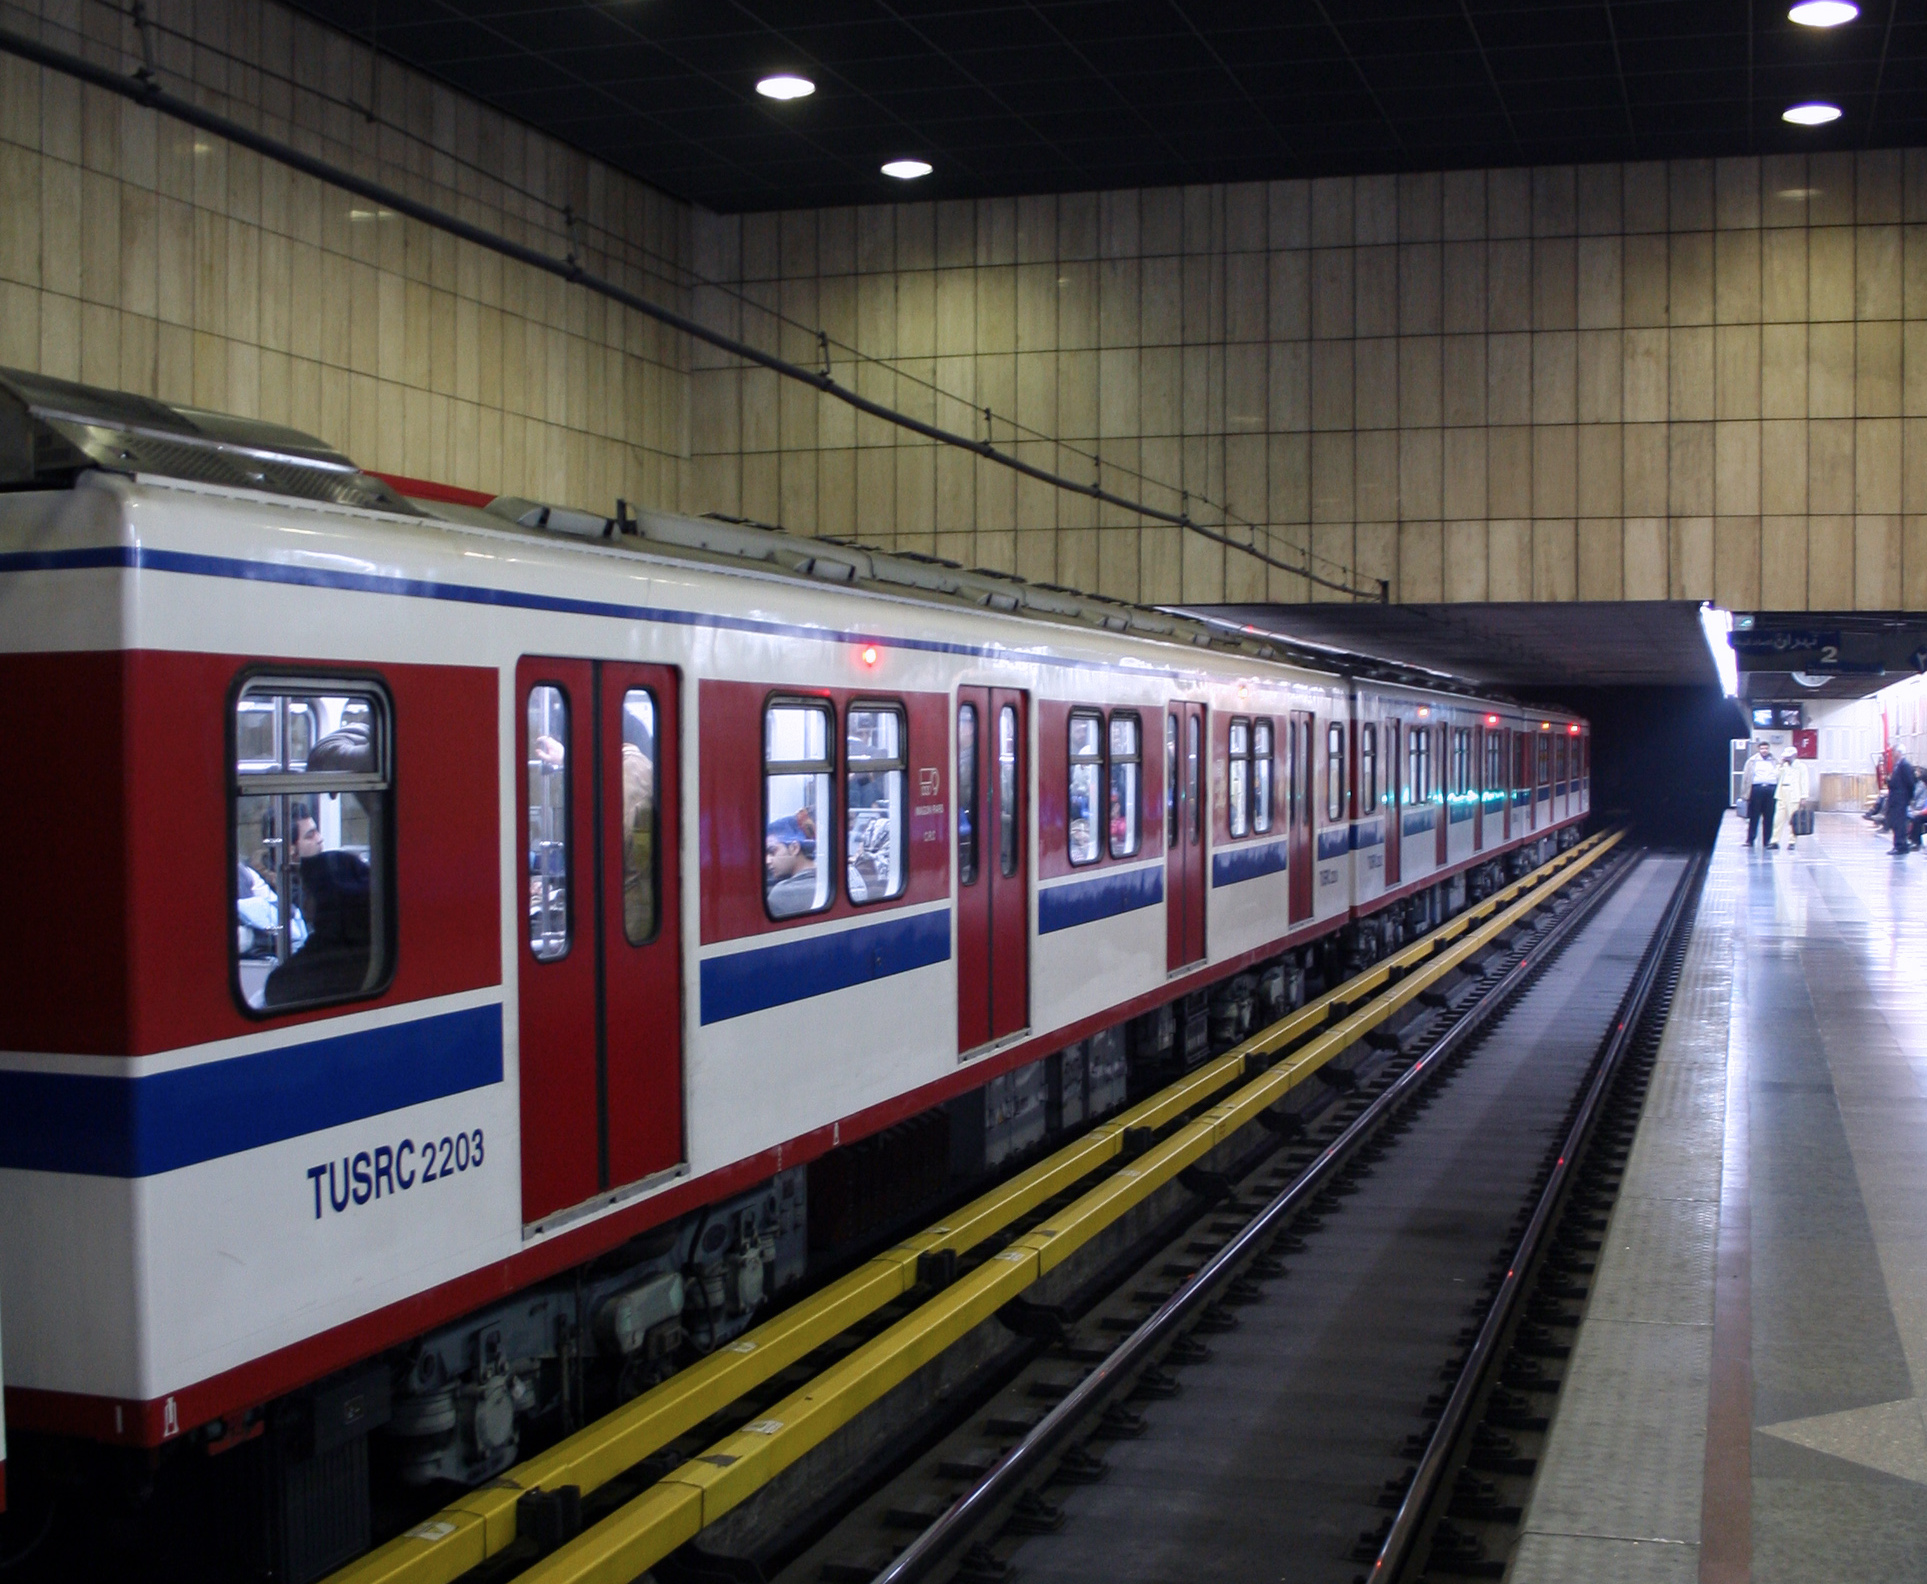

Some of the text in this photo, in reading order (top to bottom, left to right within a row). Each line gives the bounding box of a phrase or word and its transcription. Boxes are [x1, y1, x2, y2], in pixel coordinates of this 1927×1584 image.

[1820, 646, 1838, 663] 2
[1802, 738, 1810, 748] F
[307, 1128, 485, 1220] TUSRC 2203
